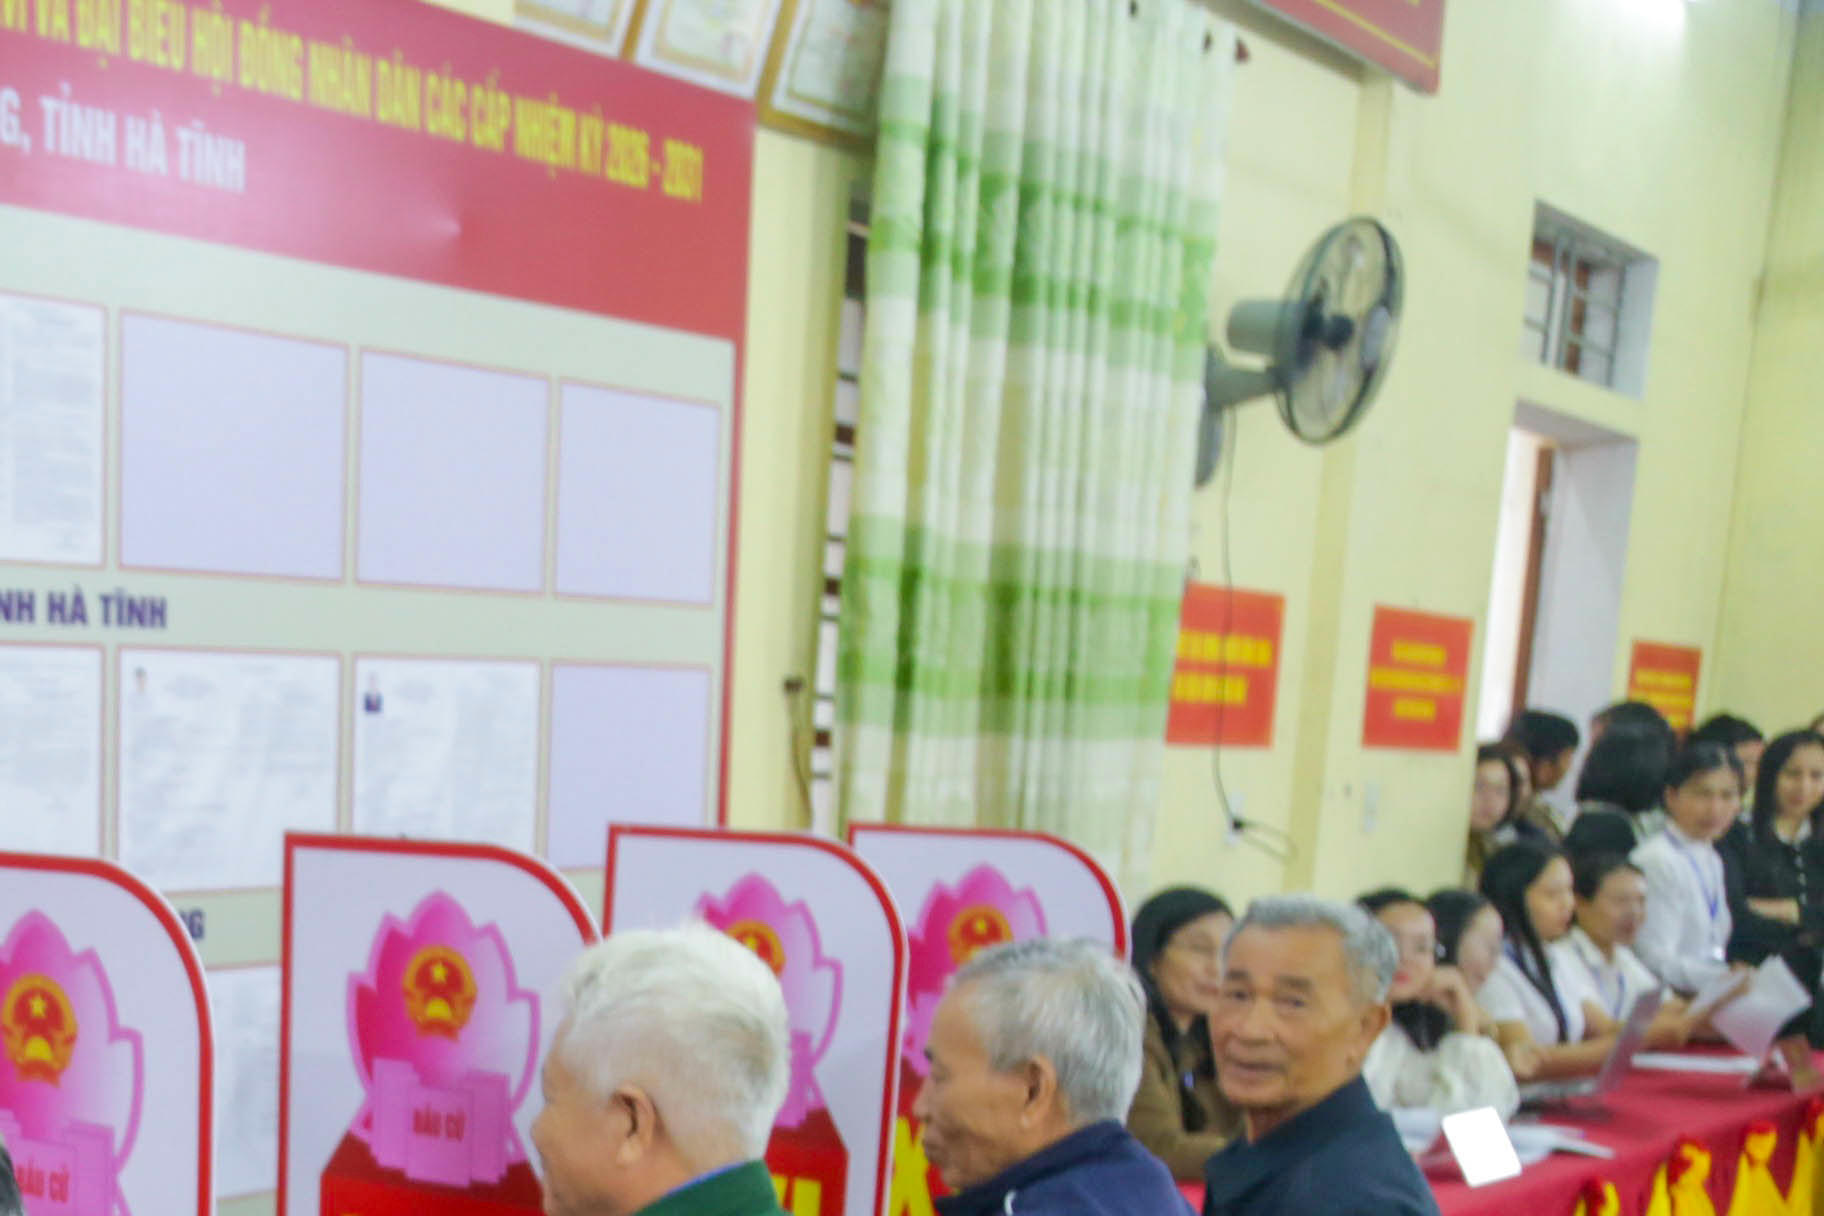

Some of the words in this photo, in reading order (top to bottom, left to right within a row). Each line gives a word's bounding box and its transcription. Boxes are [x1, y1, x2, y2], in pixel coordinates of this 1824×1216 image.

[39, 79, 118, 166] TỈNH
[124, 107, 169, 177] HÀ
[176, 118, 247, 194] TĨNH
[427, 61, 467, 142] CÁC
[47, 583, 89, 627] HÀ
[98, 586, 169, 630] TĨNH
